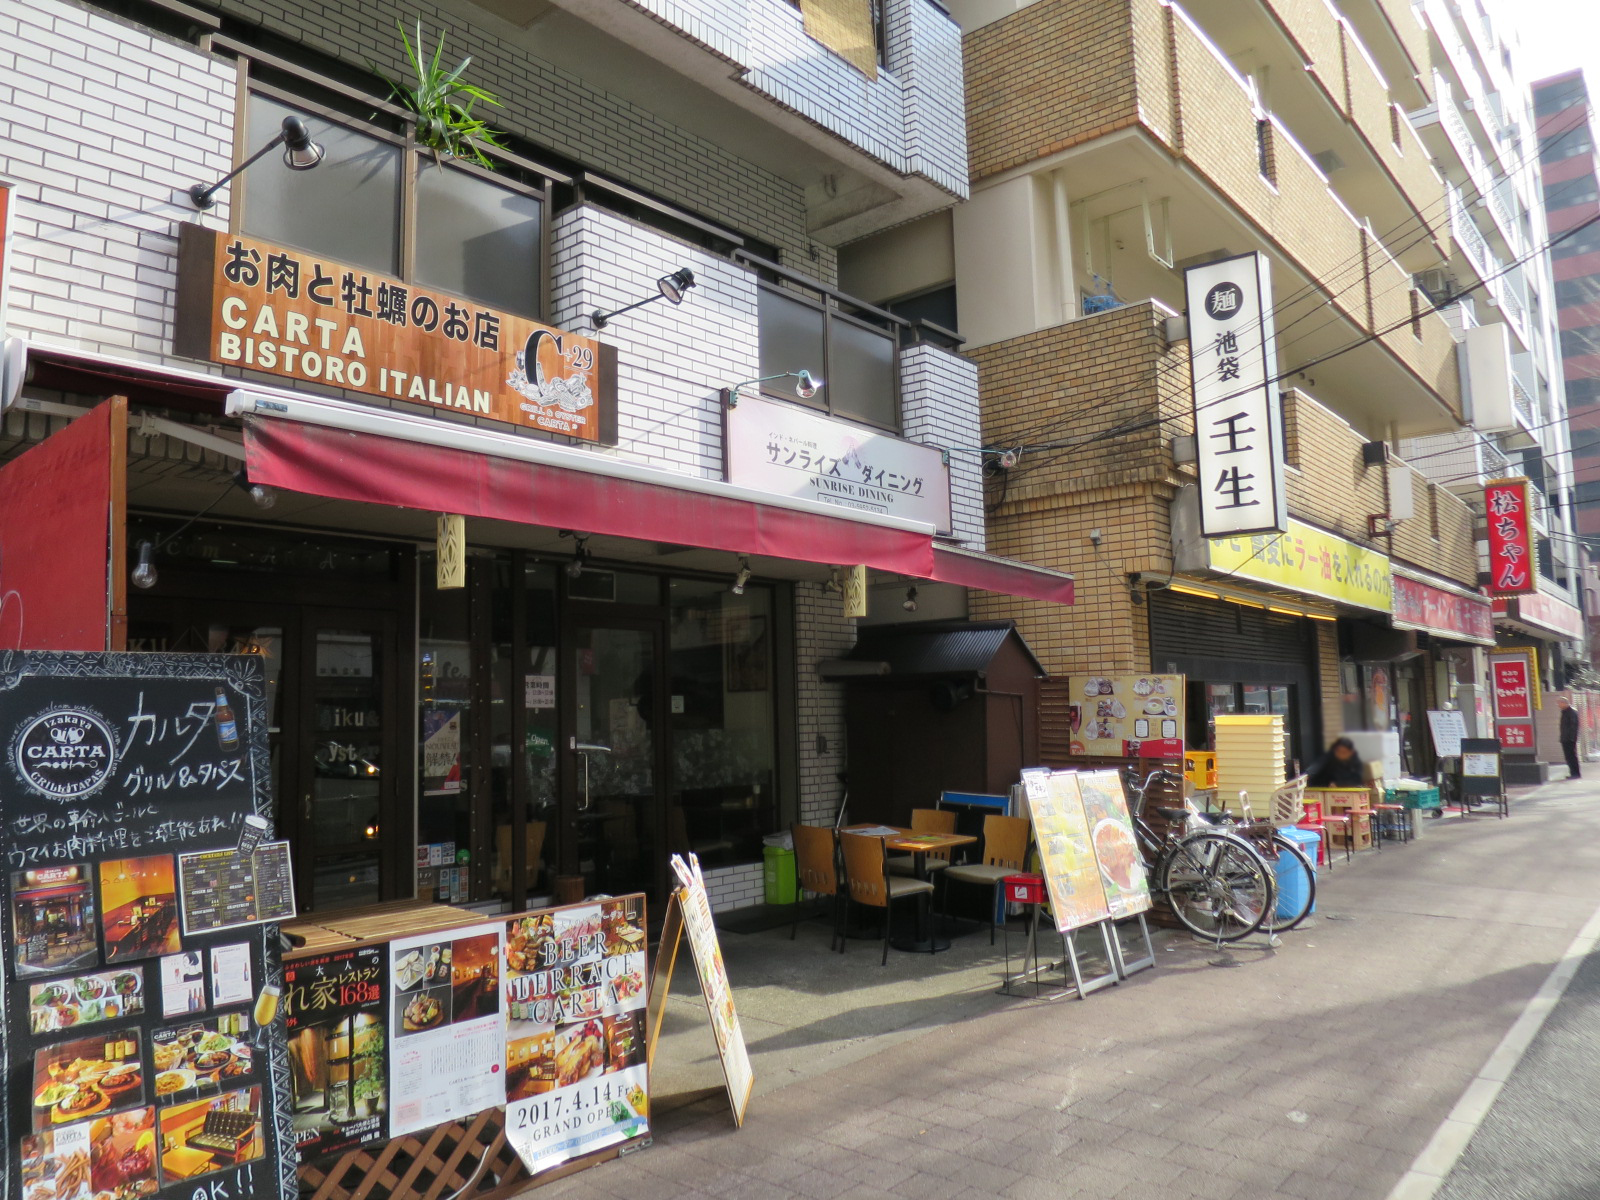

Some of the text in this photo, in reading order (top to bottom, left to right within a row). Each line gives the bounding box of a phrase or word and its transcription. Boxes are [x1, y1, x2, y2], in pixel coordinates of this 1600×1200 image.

[223, 240, 500, 352] お肉と牡蠣のお店
[1212, 287, 1237, 315] 麺
[221, 296, 366, 358] CARTA
[219, 331, 491, 414] BISTORO ITALIAN
[1214, 331, 1241, 383] 池袋
[520, 402, 545, 416] GRILL
[555, 410, 586, 425] OYSTER
[766, 441, 924, 495] サンライズ ダイニング
[1209, 411, 1261, 511] 壬生
[809, 475, 894, 503] SUNRISE DINING
[1489, 490, 1526, 590] 松ちゃん
[43, 715, 93, 731] Izakaya
[119, 691, 216, 765] カルタ
[27, 745, 106, 759] CARTA
[71, 769, 104, 793] TAPAS
[123, 760, 246, 797] グリル&タパス
[544, 931, 608, 967] BEER
[338, 967, 380, 985] レストラン
[339, 981, 380, 1007] 168選
[515, 953, 634, 1001] TERRACE
[532, 984, 620, 1026] CARTA
[153, 1031, 177, 1040] CARTA
[518, 1081, 612, 1130] 2017.4.14
[532, 1114, 583, 1143] GRAND
[586, 1103, 622, 1125] OPEN
